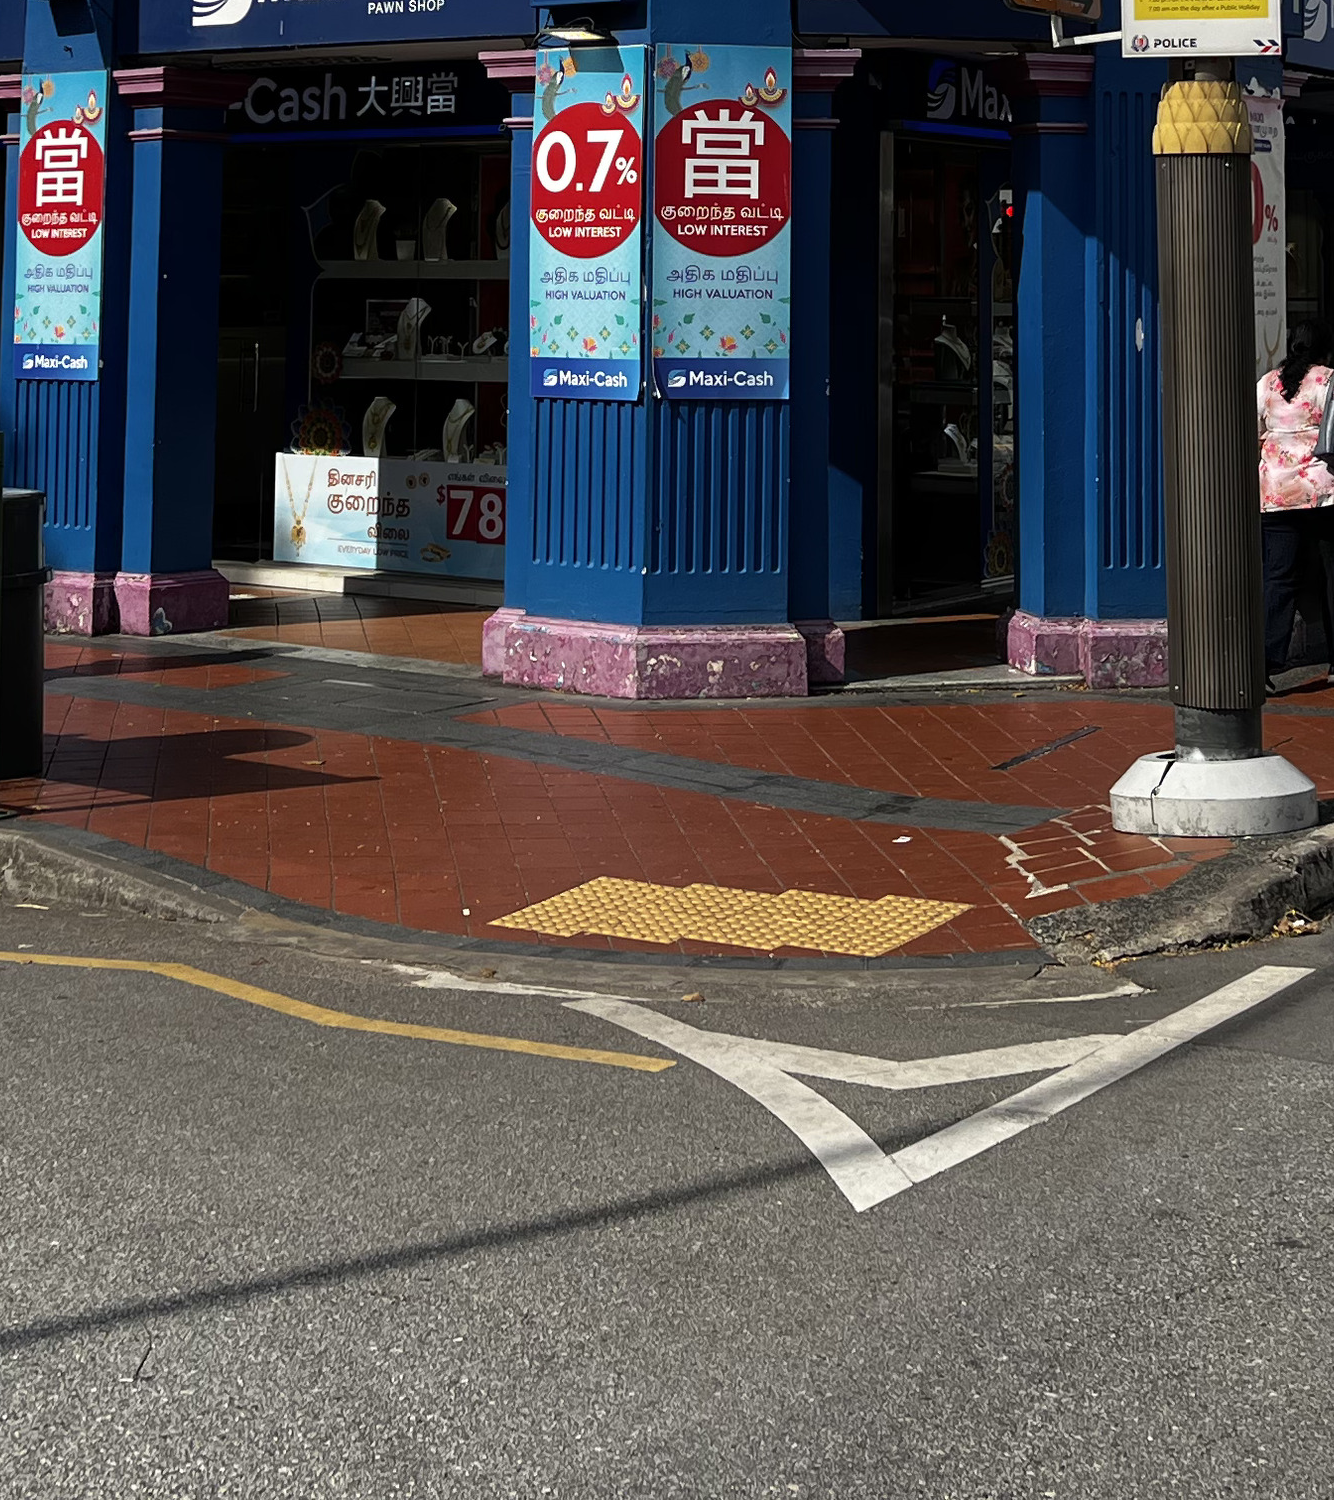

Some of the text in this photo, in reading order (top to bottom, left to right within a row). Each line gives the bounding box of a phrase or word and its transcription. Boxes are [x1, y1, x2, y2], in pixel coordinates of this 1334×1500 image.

[368, 0, 405, 15] PAWN
[1154, 38, 1197, 48] POLICE
[356, 71, 459, 119] 大興當
[535, 128, 638, 194] 0.7%
[680, 108, 766, 200] 當
[35, 127, 88, 208] 當
[535, 202, 636, 224] குறைந்த வட்டி
[660, 201, 784, 222] குறைந்த வட்டி
[31, 228, 88, 239] LOW INTEREST
[548, 225, 622, 239] LOW INTEREST
[677, 224, 768, 237] LOW INTEREST
[545, 289, 626, 301] HIGH VALUATION
[673, 288, 774, 300] HIGH VALUATION
[34, 353, 88, 370] Maxi-Cash
[559, 369, 628, 388] Maxi-Cash
[689, 370, 774, 388] Maxi-Cash
[327, 491, 410, 517] குறைந்த
